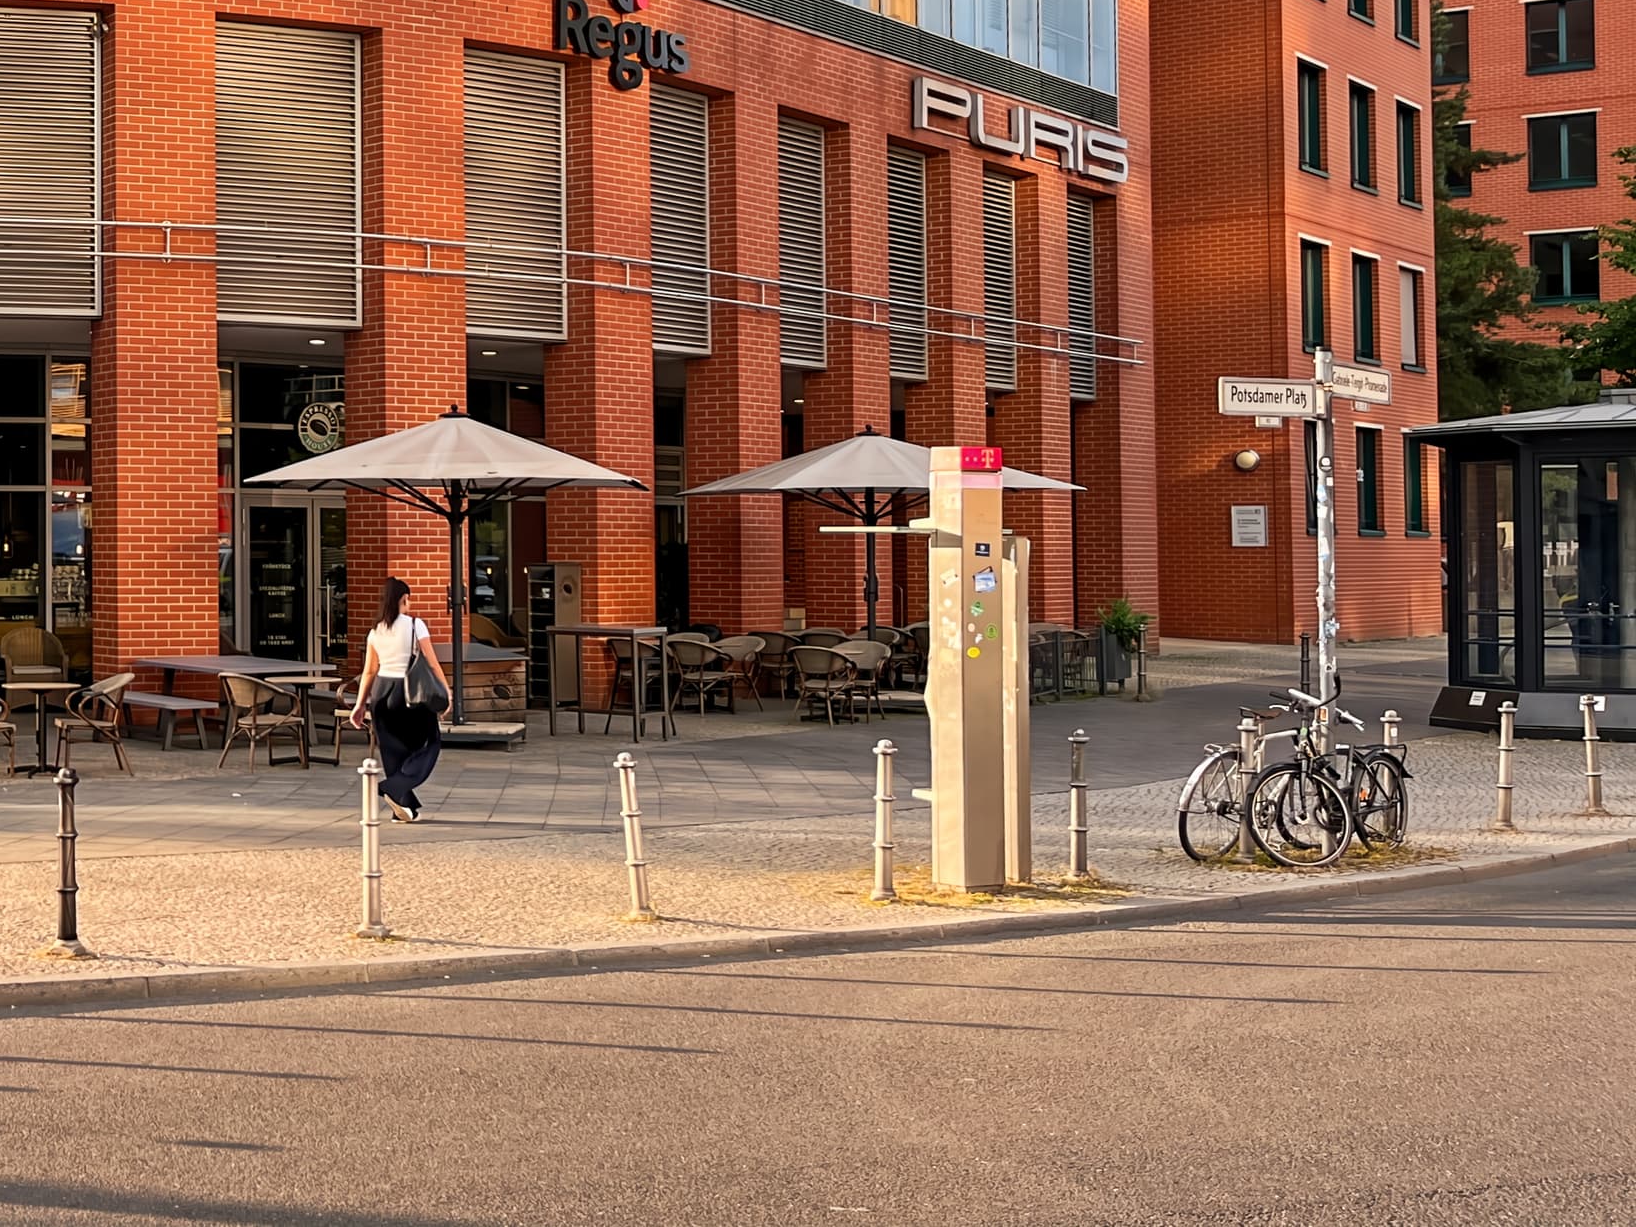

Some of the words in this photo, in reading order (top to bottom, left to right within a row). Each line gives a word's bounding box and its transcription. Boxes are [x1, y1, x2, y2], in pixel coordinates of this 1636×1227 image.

[912, 75, 1129, 184] PURIS
[1230, 385, 1284, 405] Potsdamer
[1285, 387, 1308, 409] Platz
